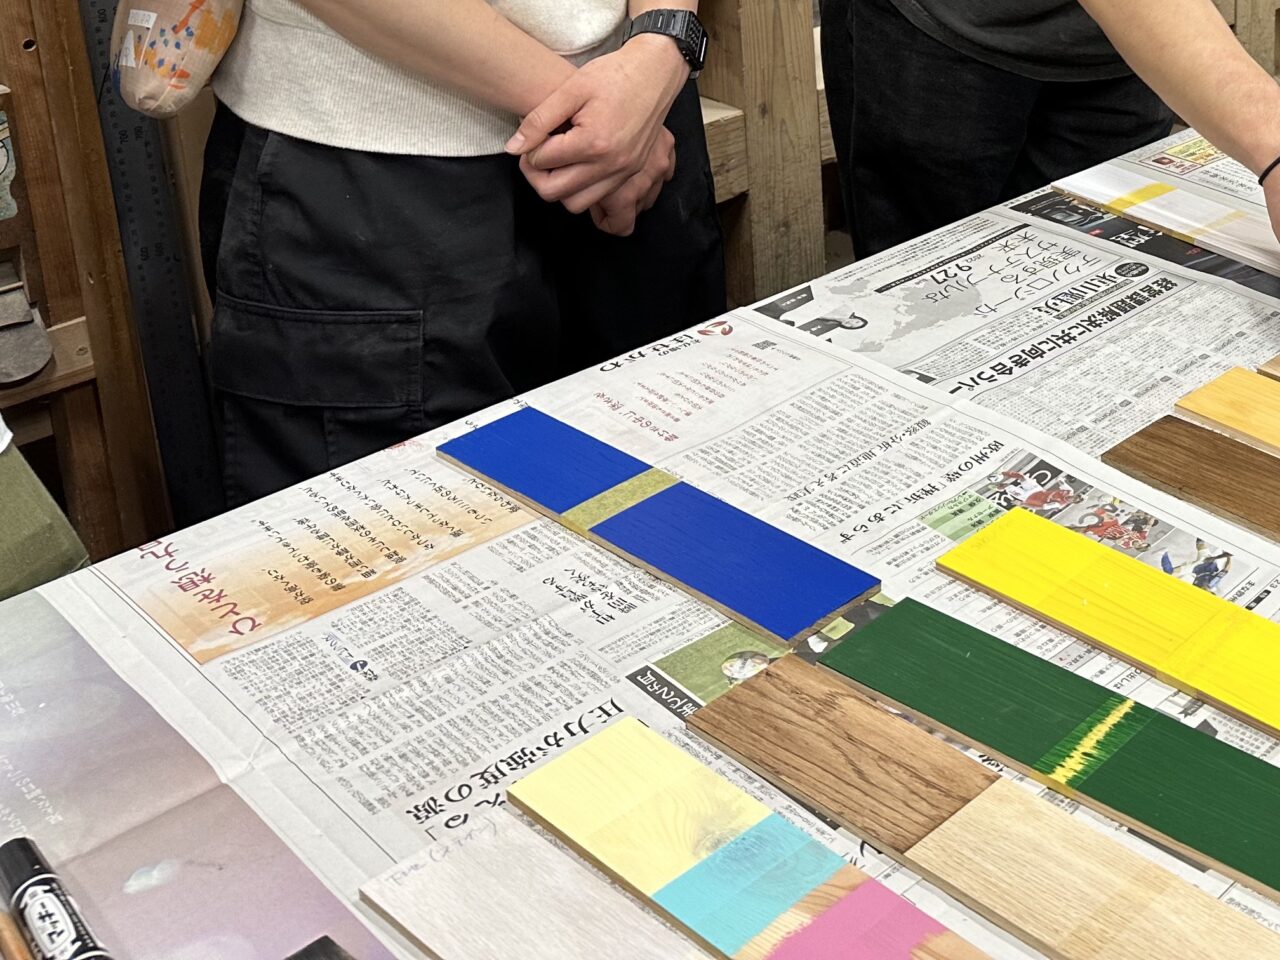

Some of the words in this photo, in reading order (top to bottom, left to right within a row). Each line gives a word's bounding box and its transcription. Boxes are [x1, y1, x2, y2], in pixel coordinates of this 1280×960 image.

[922, 234, 1060, 308] サステナブルな
[990, 228, 1034, 258] 未来
[998, 242, 1080, 290] 実現する
[971, 250, 1103, 321] テクノロジーが
[599, 331, 694, 376] はせがわ
[947, 274, 1178, 396] 経営課題解決に共に向き合うパー
[378, 475, 464, 539] 遠くなってしまったけれど、
[404, 463, 493, 525] いつもこころの近くにいて、
[836, 438, 1005, 546] 欧州の壁「挫折」にあらず
[251, 517, 345, 592] 雲の姿も変わってきています。
[261, 565, 314, 605] 空が高くなり、
[406, 698, 624, 824] 圧力が強度の源
